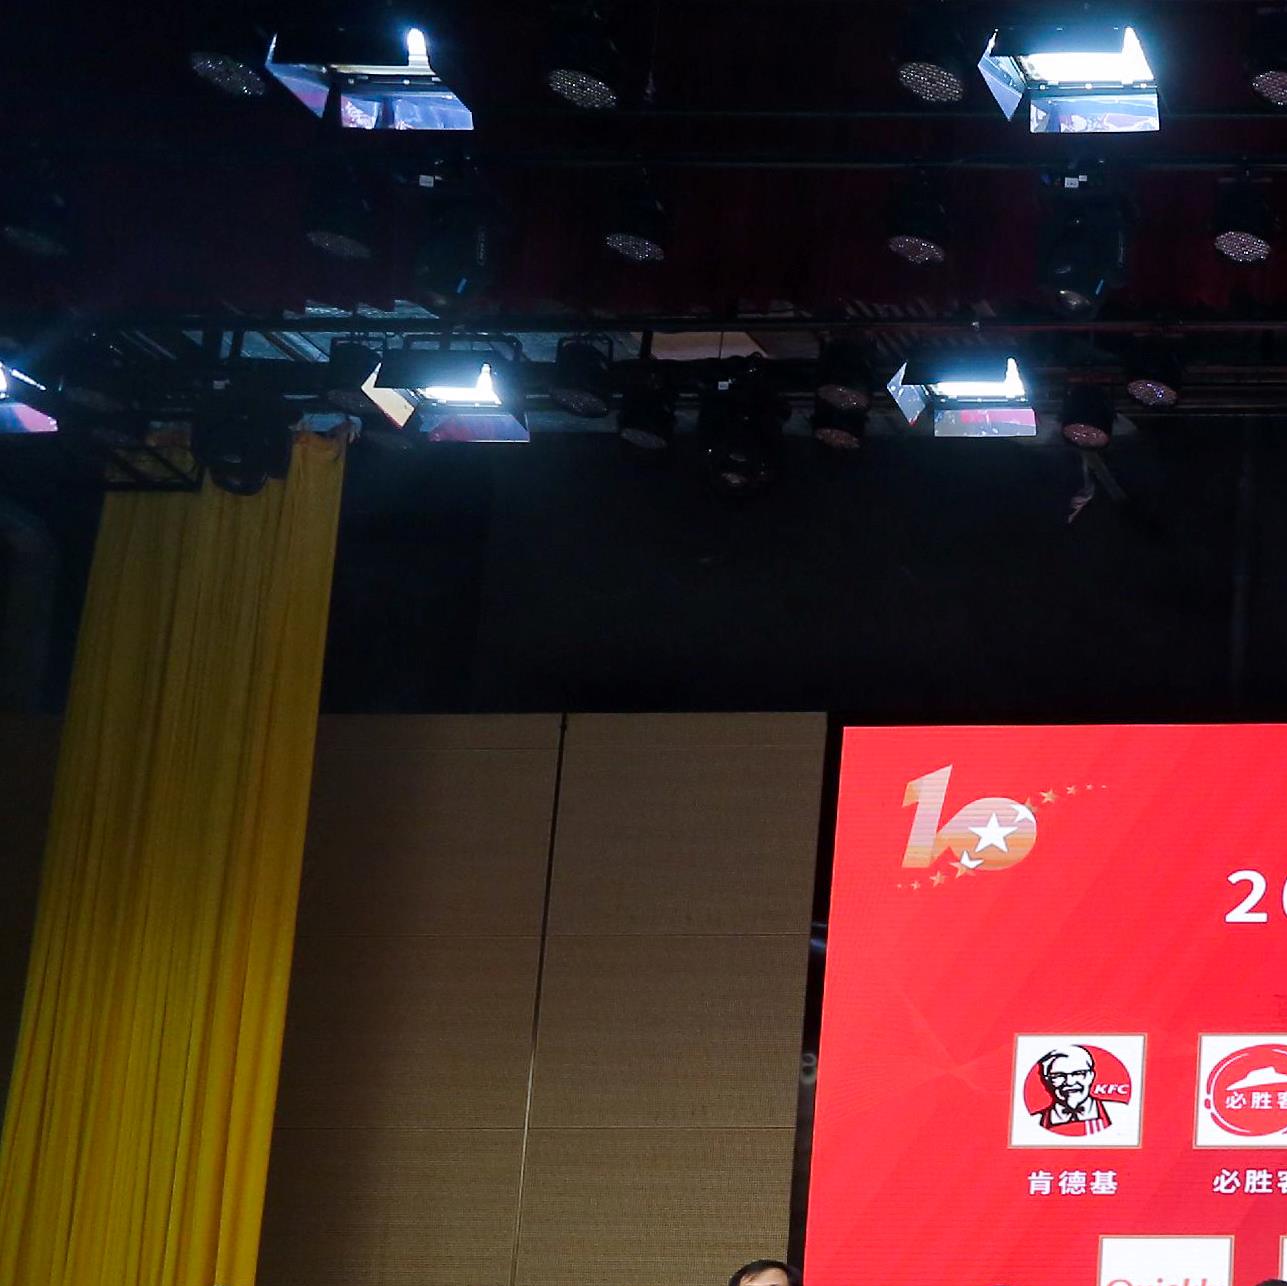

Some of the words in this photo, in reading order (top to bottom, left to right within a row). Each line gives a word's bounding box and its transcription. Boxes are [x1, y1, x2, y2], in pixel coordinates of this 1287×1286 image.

[1094, 1084, 1129, 1095] KFC
[1028, 1170, 1118, 1195] 肯德基
